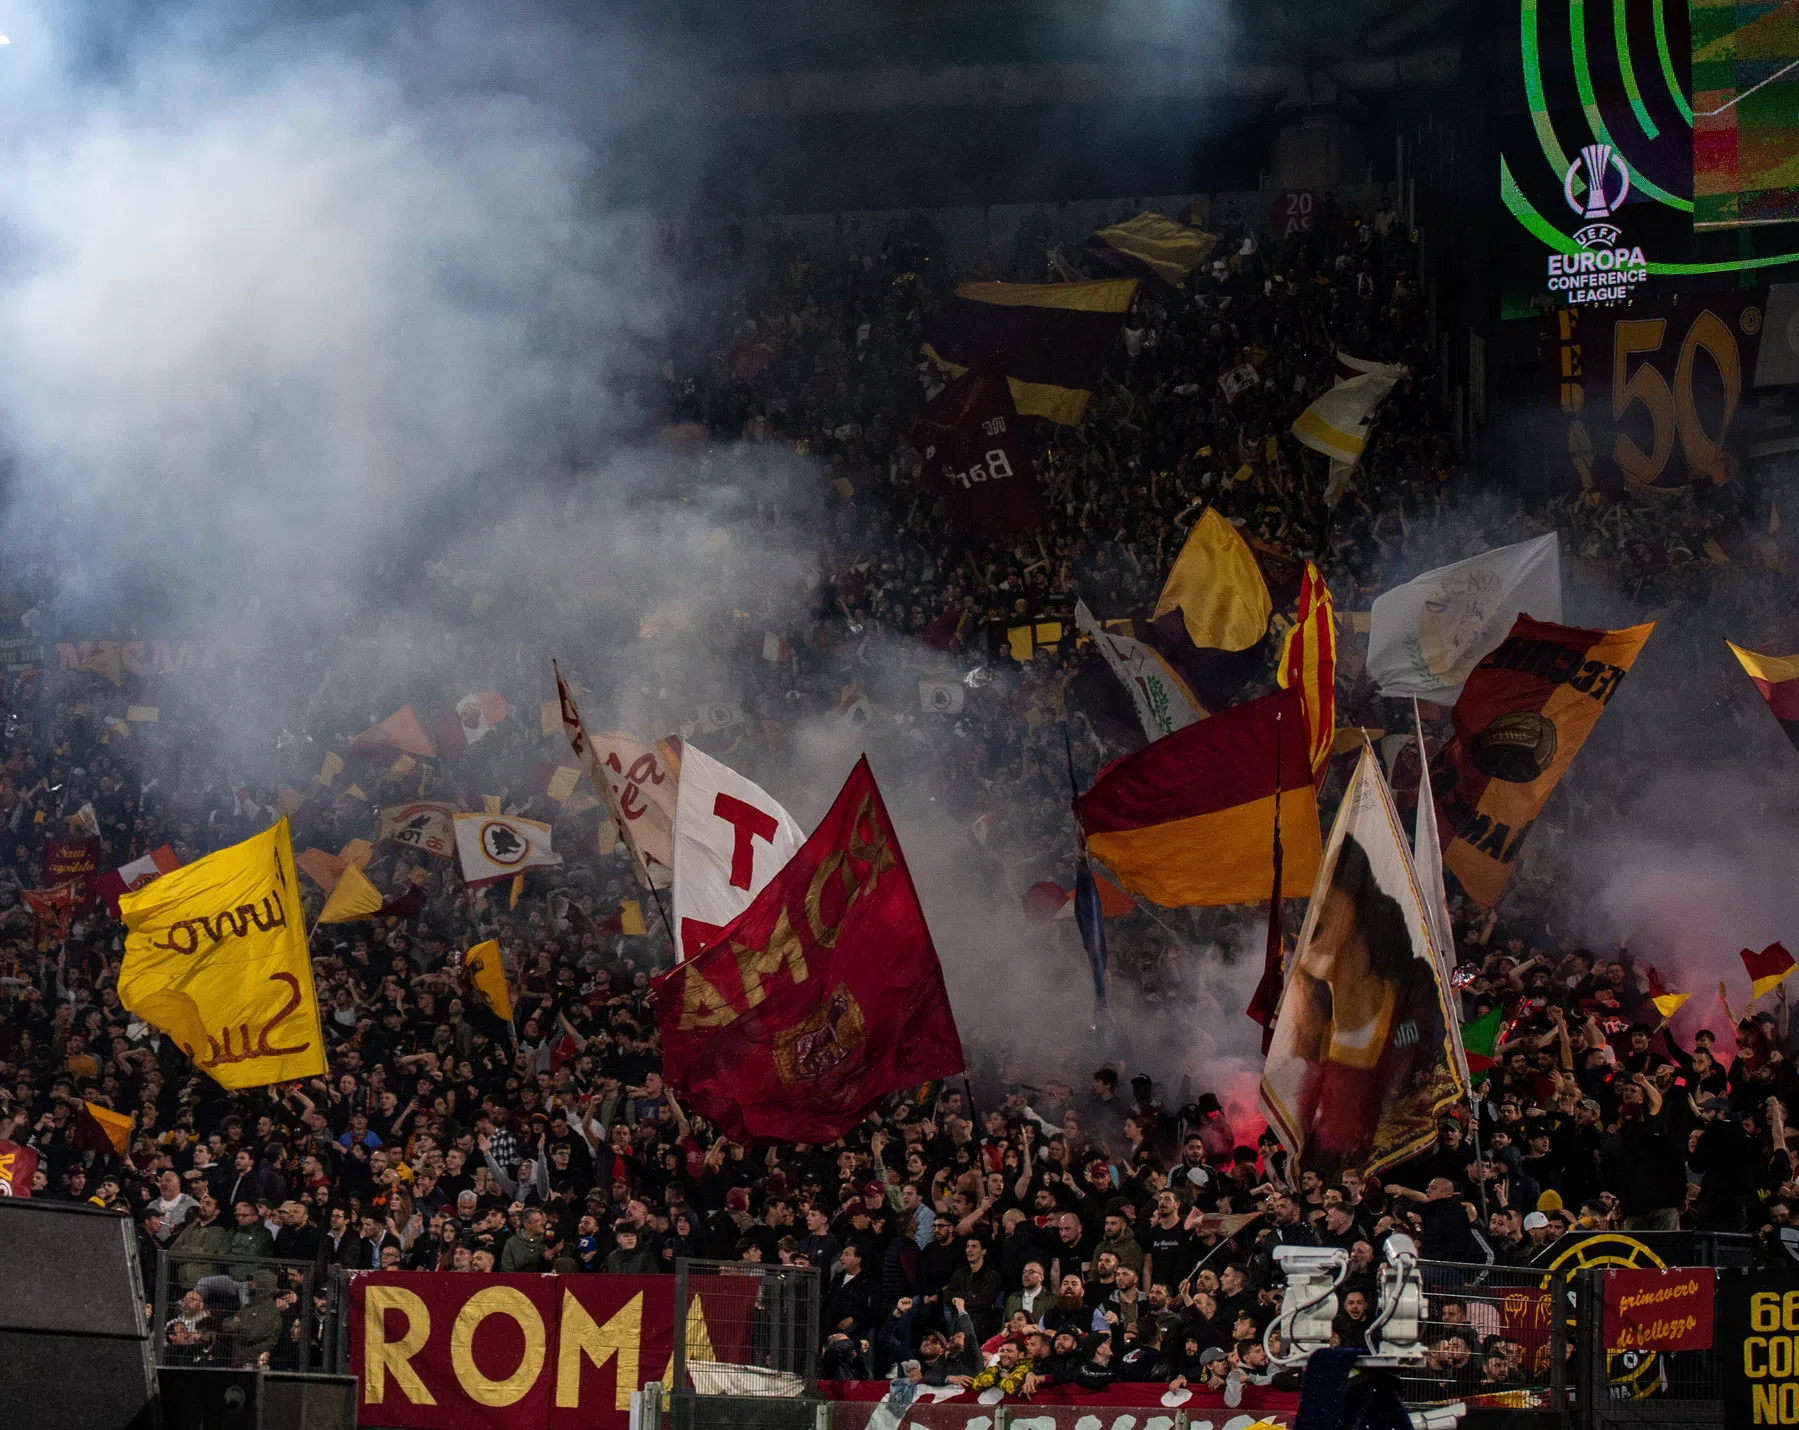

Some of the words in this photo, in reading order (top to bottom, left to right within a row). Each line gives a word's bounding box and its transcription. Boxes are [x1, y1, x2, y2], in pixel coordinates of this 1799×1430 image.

[1285, 192, 1313, 216] 20
[1574, 227, 1619, 247] UEFA
[1547, 246, 1648, 277] EUROPA
[1547, 269, 1648, 291] CONFERENCE
[713, 791, 779, 892] T
[1619, 1279, 1699, 1319] primavera
[1617, 1325, 1635, 1349] di
[1635, 1314, 1697, 1347] bellezza
[1743, 1335, 1799, 1379] CO
